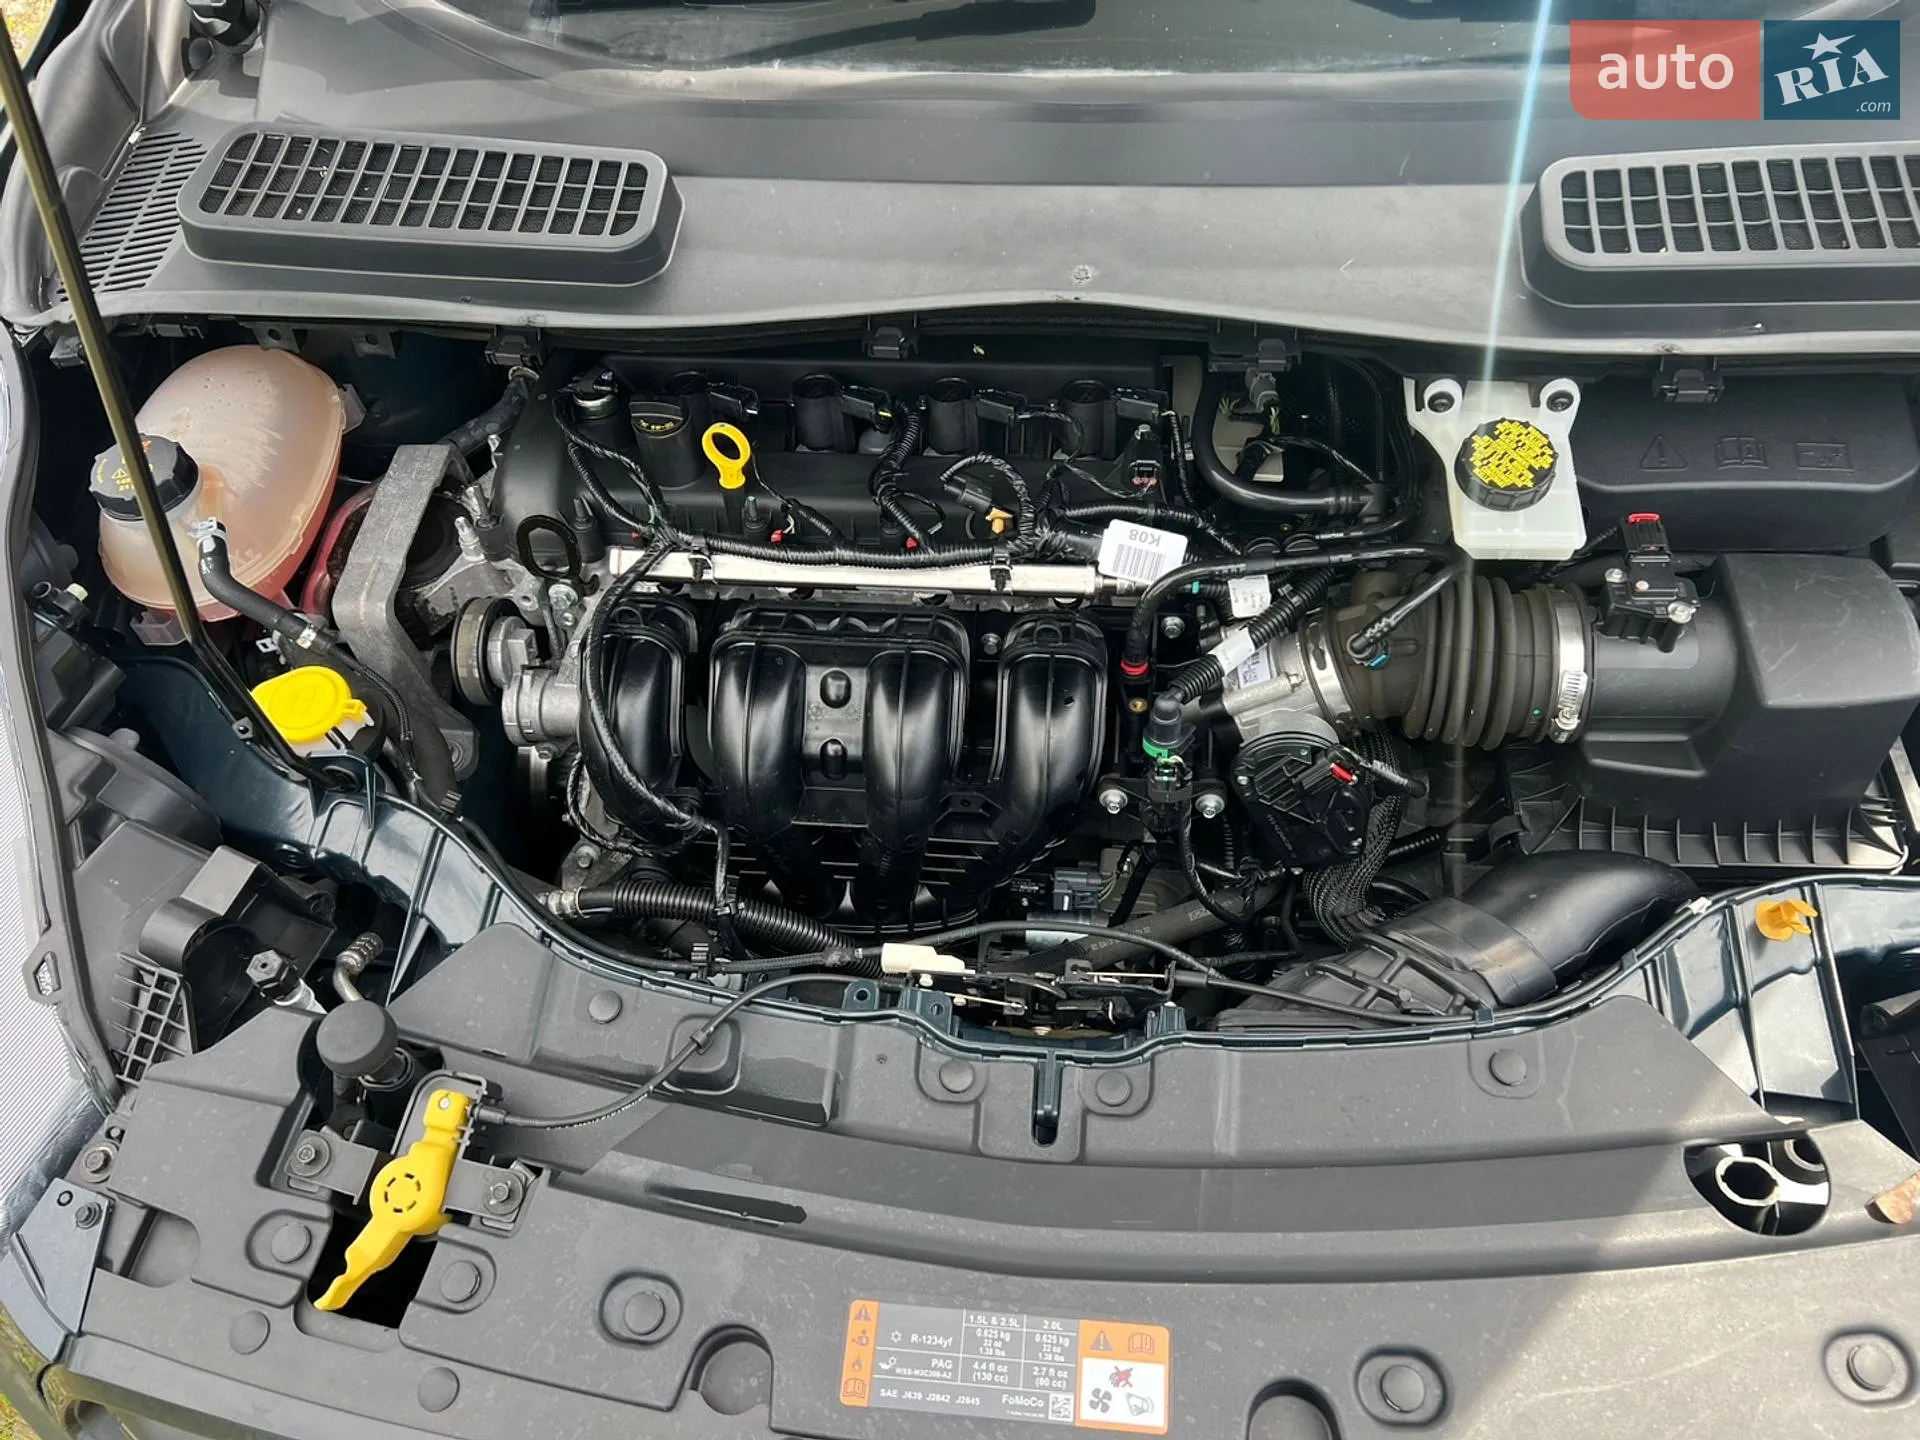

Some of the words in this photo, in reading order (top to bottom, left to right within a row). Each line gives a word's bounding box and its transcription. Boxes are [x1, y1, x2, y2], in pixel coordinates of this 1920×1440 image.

[1128, 528, 1162, 546] K08
[969, 1314, 989, 1324] 1.5L
[990, 1317, 998, 1326] &
[1000, 1317, 1020, 1328] 2.5L
[1043, 1319, 1063, 1330] 2.0L
[910, 1334, 953, 1348] R-1234yf
[999, 1330, 1011, 1342] kg
[1059, 1336, 1070, 1348] kg
[931, 1358, 953, 1369] PAG
[972, 1360, 987, 1370] 4.4
[996, 1364, 1009, 1372] oz
[972, 1371, 993, 1382] (130
[993, 1374, 1009, 1384] cc)
[1032, 1366, 1047, 1376] 2.7
[1056, 1369, 1069, 1377] oz
[1051, 1379, 1067, 1390] cc)
[880, 1388, 898, 1398] SAE
[1001, 1394, 1045, 1408] FoMoCo
